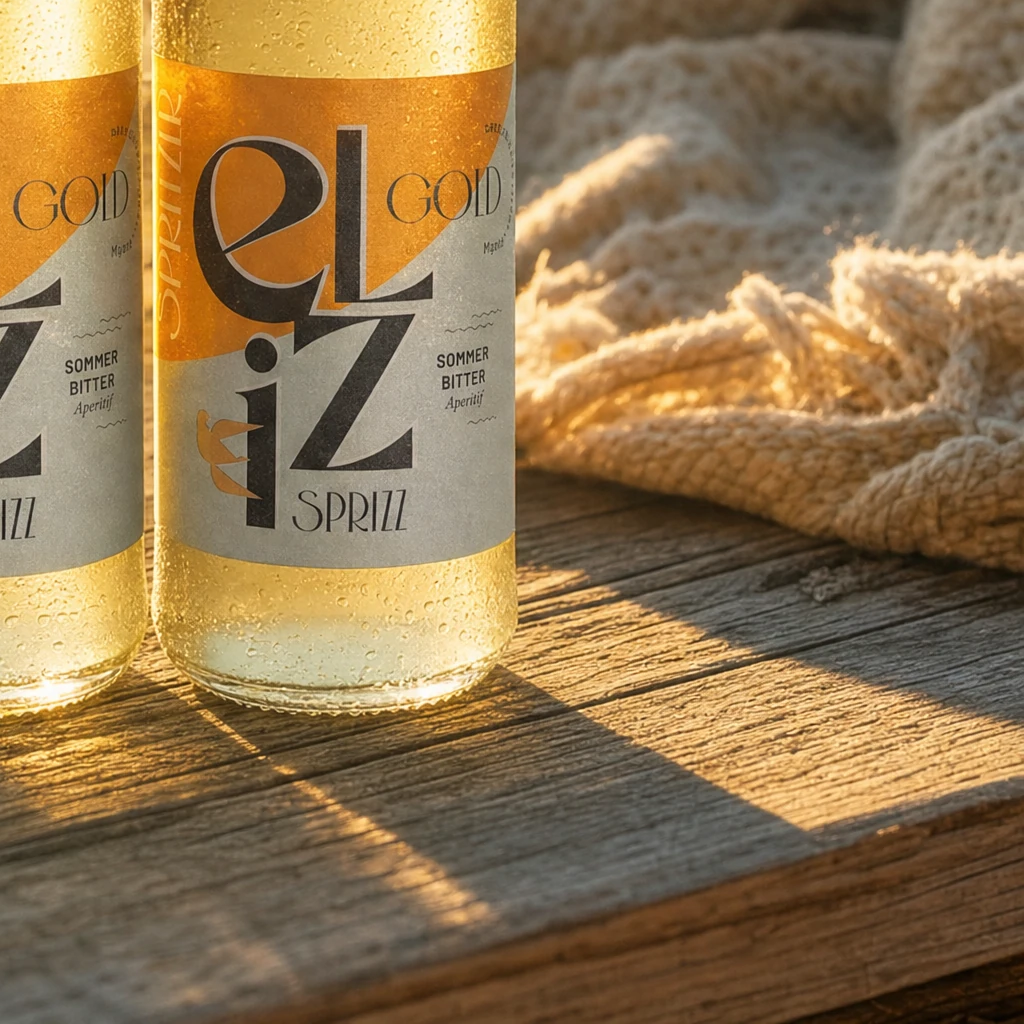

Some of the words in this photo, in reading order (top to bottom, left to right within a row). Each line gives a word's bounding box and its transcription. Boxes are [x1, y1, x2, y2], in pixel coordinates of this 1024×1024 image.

[12, 168, 130, 232] GOLD
[385, 165, 502, 225] GOLD
[64, 349, 119, 375] SOMMER
[436, 345, 490, 369] SOMMER
[69, 372, 115, 396] BITTER
[441, 368, 486, 390] BITTER
[73, 392, 115, 419] Aperitif
[444, 388, 485, 413] Aperitif
[291, 488, 409, 534] SPRIZZ
